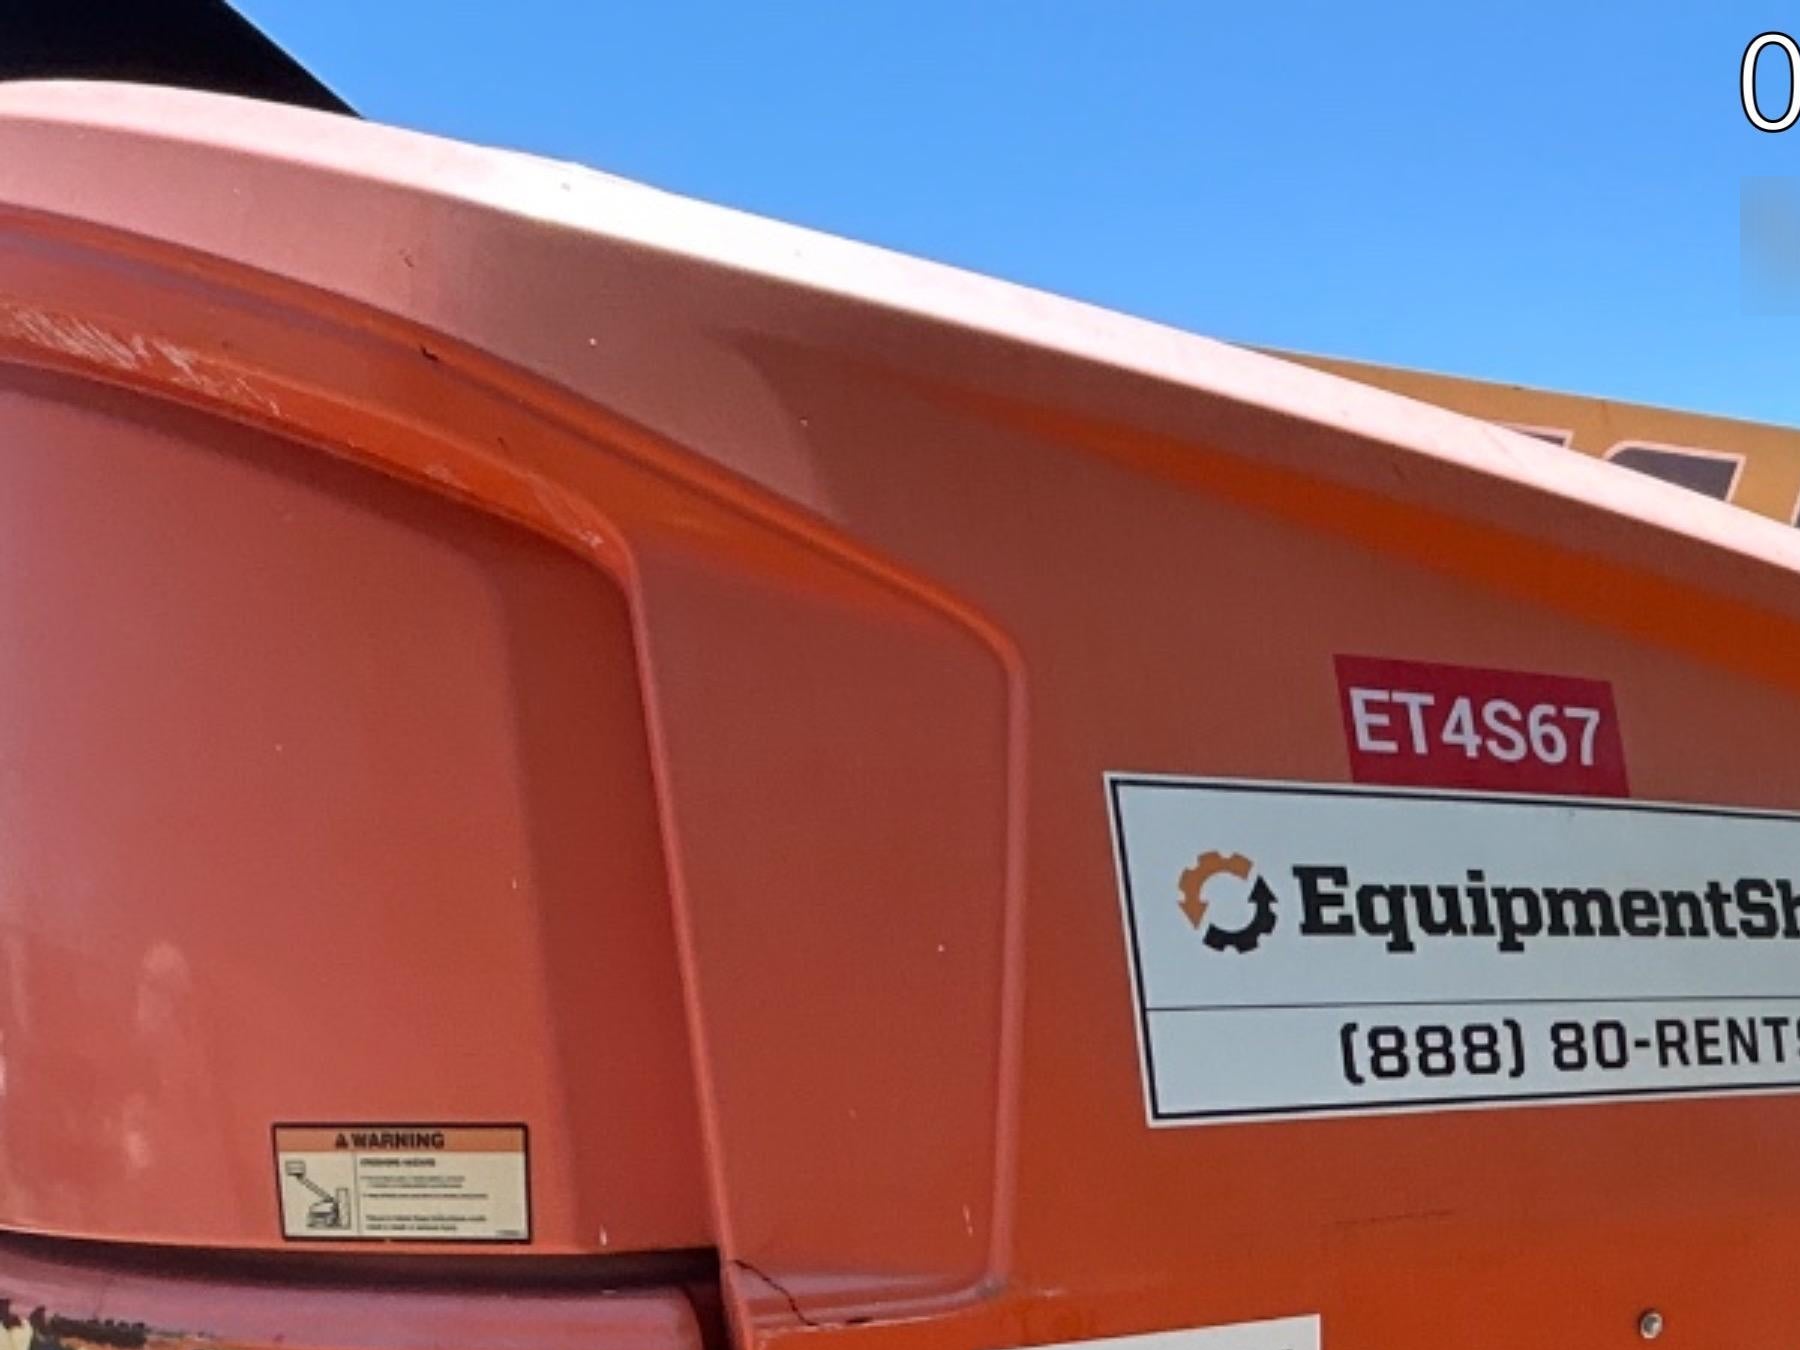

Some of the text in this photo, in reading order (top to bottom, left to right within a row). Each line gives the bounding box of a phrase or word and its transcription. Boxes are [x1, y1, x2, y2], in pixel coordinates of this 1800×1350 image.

[1348, 686, 1601, 767] ET4S67
[1339, 1020, 1526, 1085] (888)
[351, 1132, 446, 1150] WARNING
